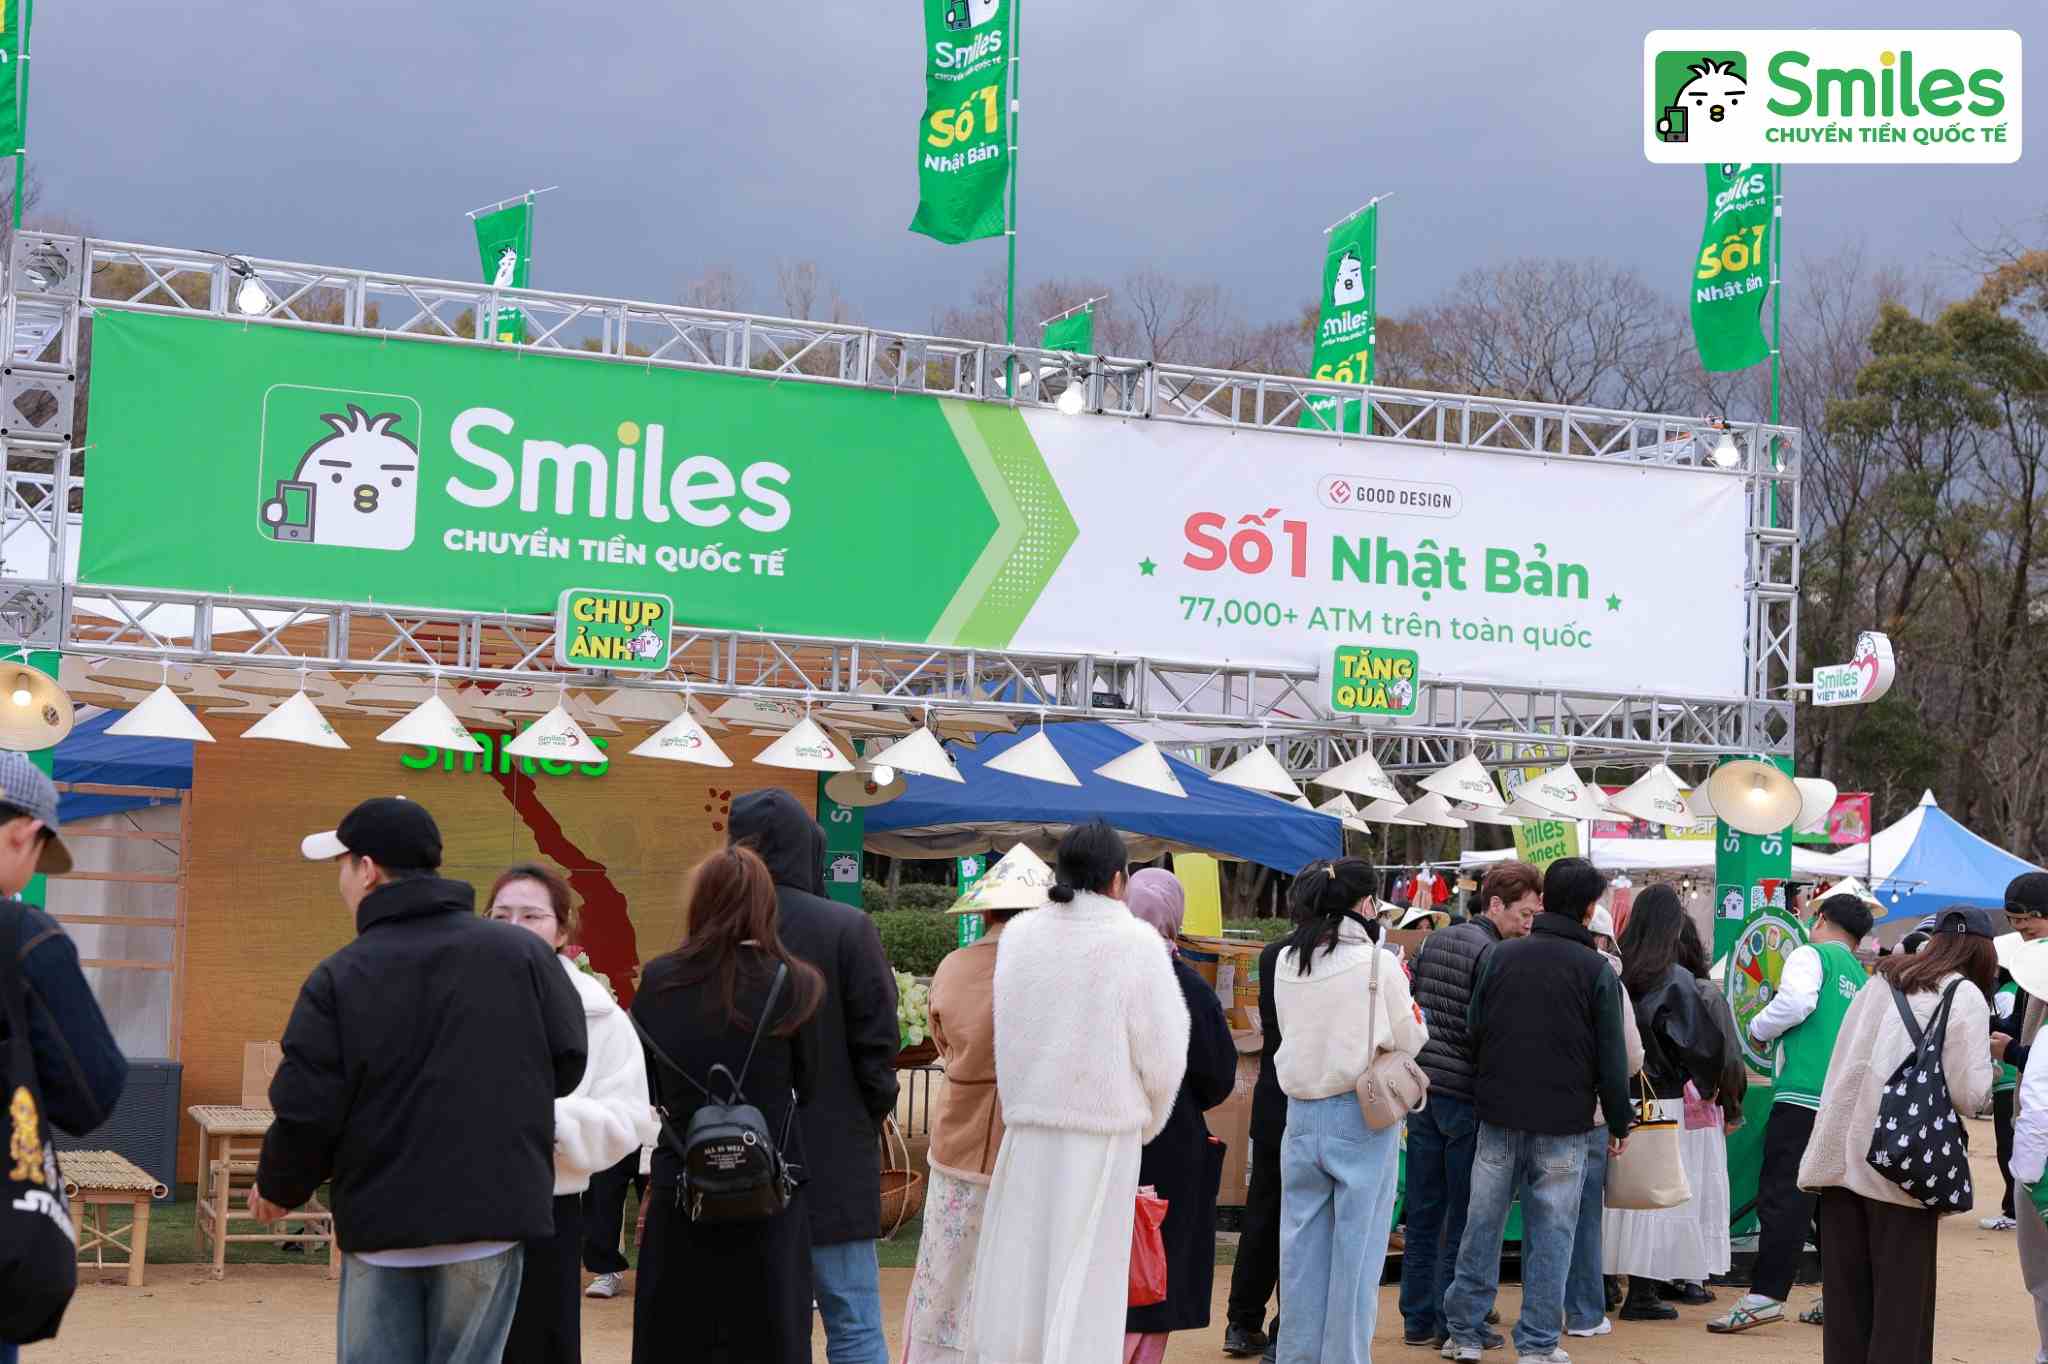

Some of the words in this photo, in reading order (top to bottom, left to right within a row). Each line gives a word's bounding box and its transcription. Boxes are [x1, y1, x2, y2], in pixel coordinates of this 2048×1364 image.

[935, 30, 1002, 69] Smiles
[924, 153, 965, 174] Nhật
[967, 142, 999, 165] Bản
[1696, 281, 1743, 303] Nhật
[445, 407, 792, 532] Smiles
[1356, 487, 1395, 504] GOOD
[1400, 491, 1451, 509] DESIGN
[443, 527, 570, 559] CHUYỂN
[578, 534, 646, 565] TIỀN
[655, 542, 742, 573] QUỐC
[749, 547, 790, 576] TẾ
[1331, 535, 1467, 601] Nhật
[1484, 543, 1590, 600] Bản
[573, 597, 662, 632] CHỤP
[1179, 595, 1299, 628] 77,000+
[1307, 606, 1373, 634] ATM
[1381, 612, 1442, 639] trên
[1450, 617, 1514, 643] toàn
[1523, 620, 1593, 651] quốc
[569, 624, 635, 661] ẢNH
[1339, 648, 1413, 686] TẶNG
[1816, 671, 1858, 689] Smiles
[1337, 682, 1390, 709] QUÀ
[1839, 688, 1858, 699] NAM
[1522, 819, 1565, 849] miles
[1528, 841, 1566, 863] nnect
